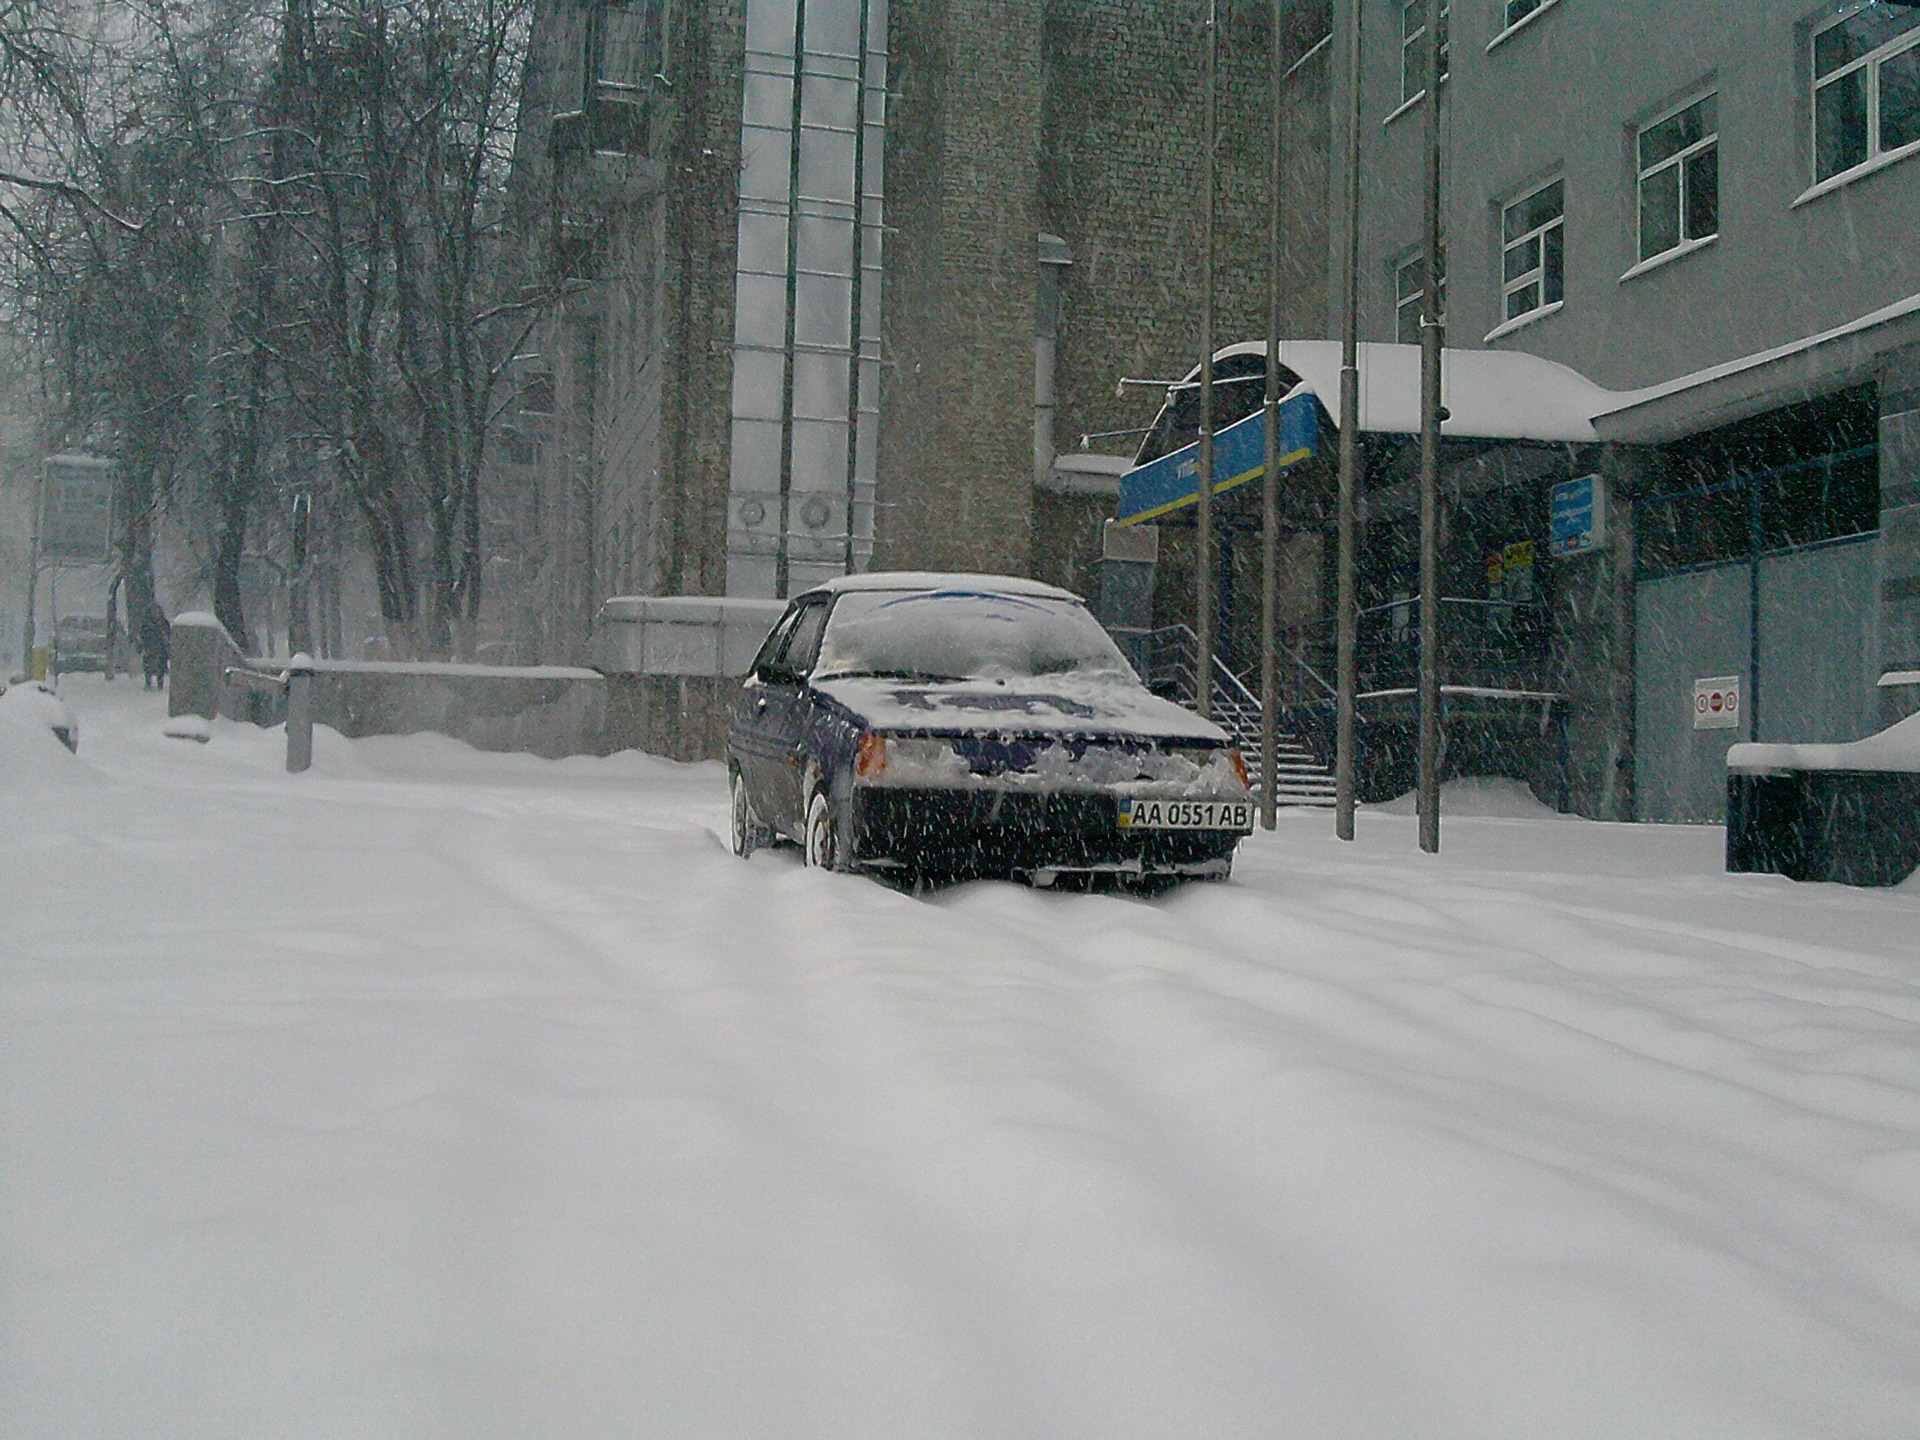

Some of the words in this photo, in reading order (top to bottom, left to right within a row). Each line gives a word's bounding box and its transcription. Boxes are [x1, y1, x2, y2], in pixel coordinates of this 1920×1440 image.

[1132, 803, 1162, 825] AA
[1168, 804, 1214, 826] 0551
[1219, 805, 1247, 826] AB
